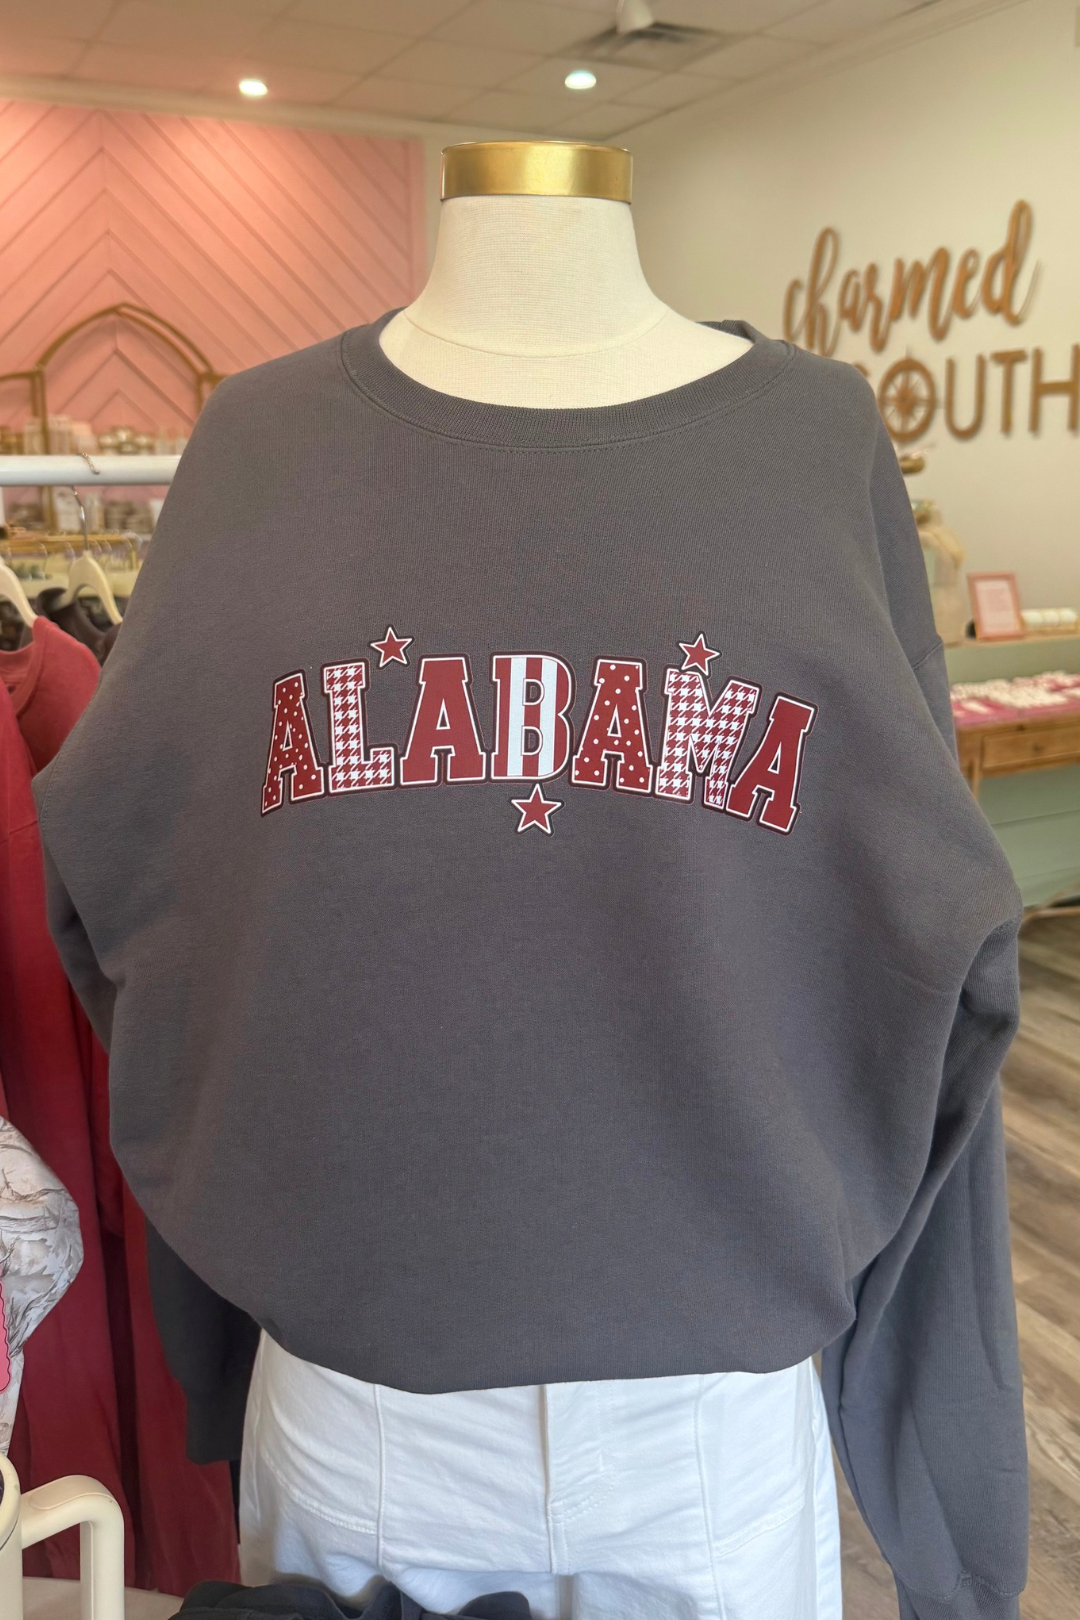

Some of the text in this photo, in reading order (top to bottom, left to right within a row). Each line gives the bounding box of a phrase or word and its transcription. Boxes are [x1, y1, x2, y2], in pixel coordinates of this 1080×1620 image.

[783, 199, 1041, 358] charmed
[854, 344, 1080, 443] OUTH
[260, 653, 817, 834] ALABAMA
